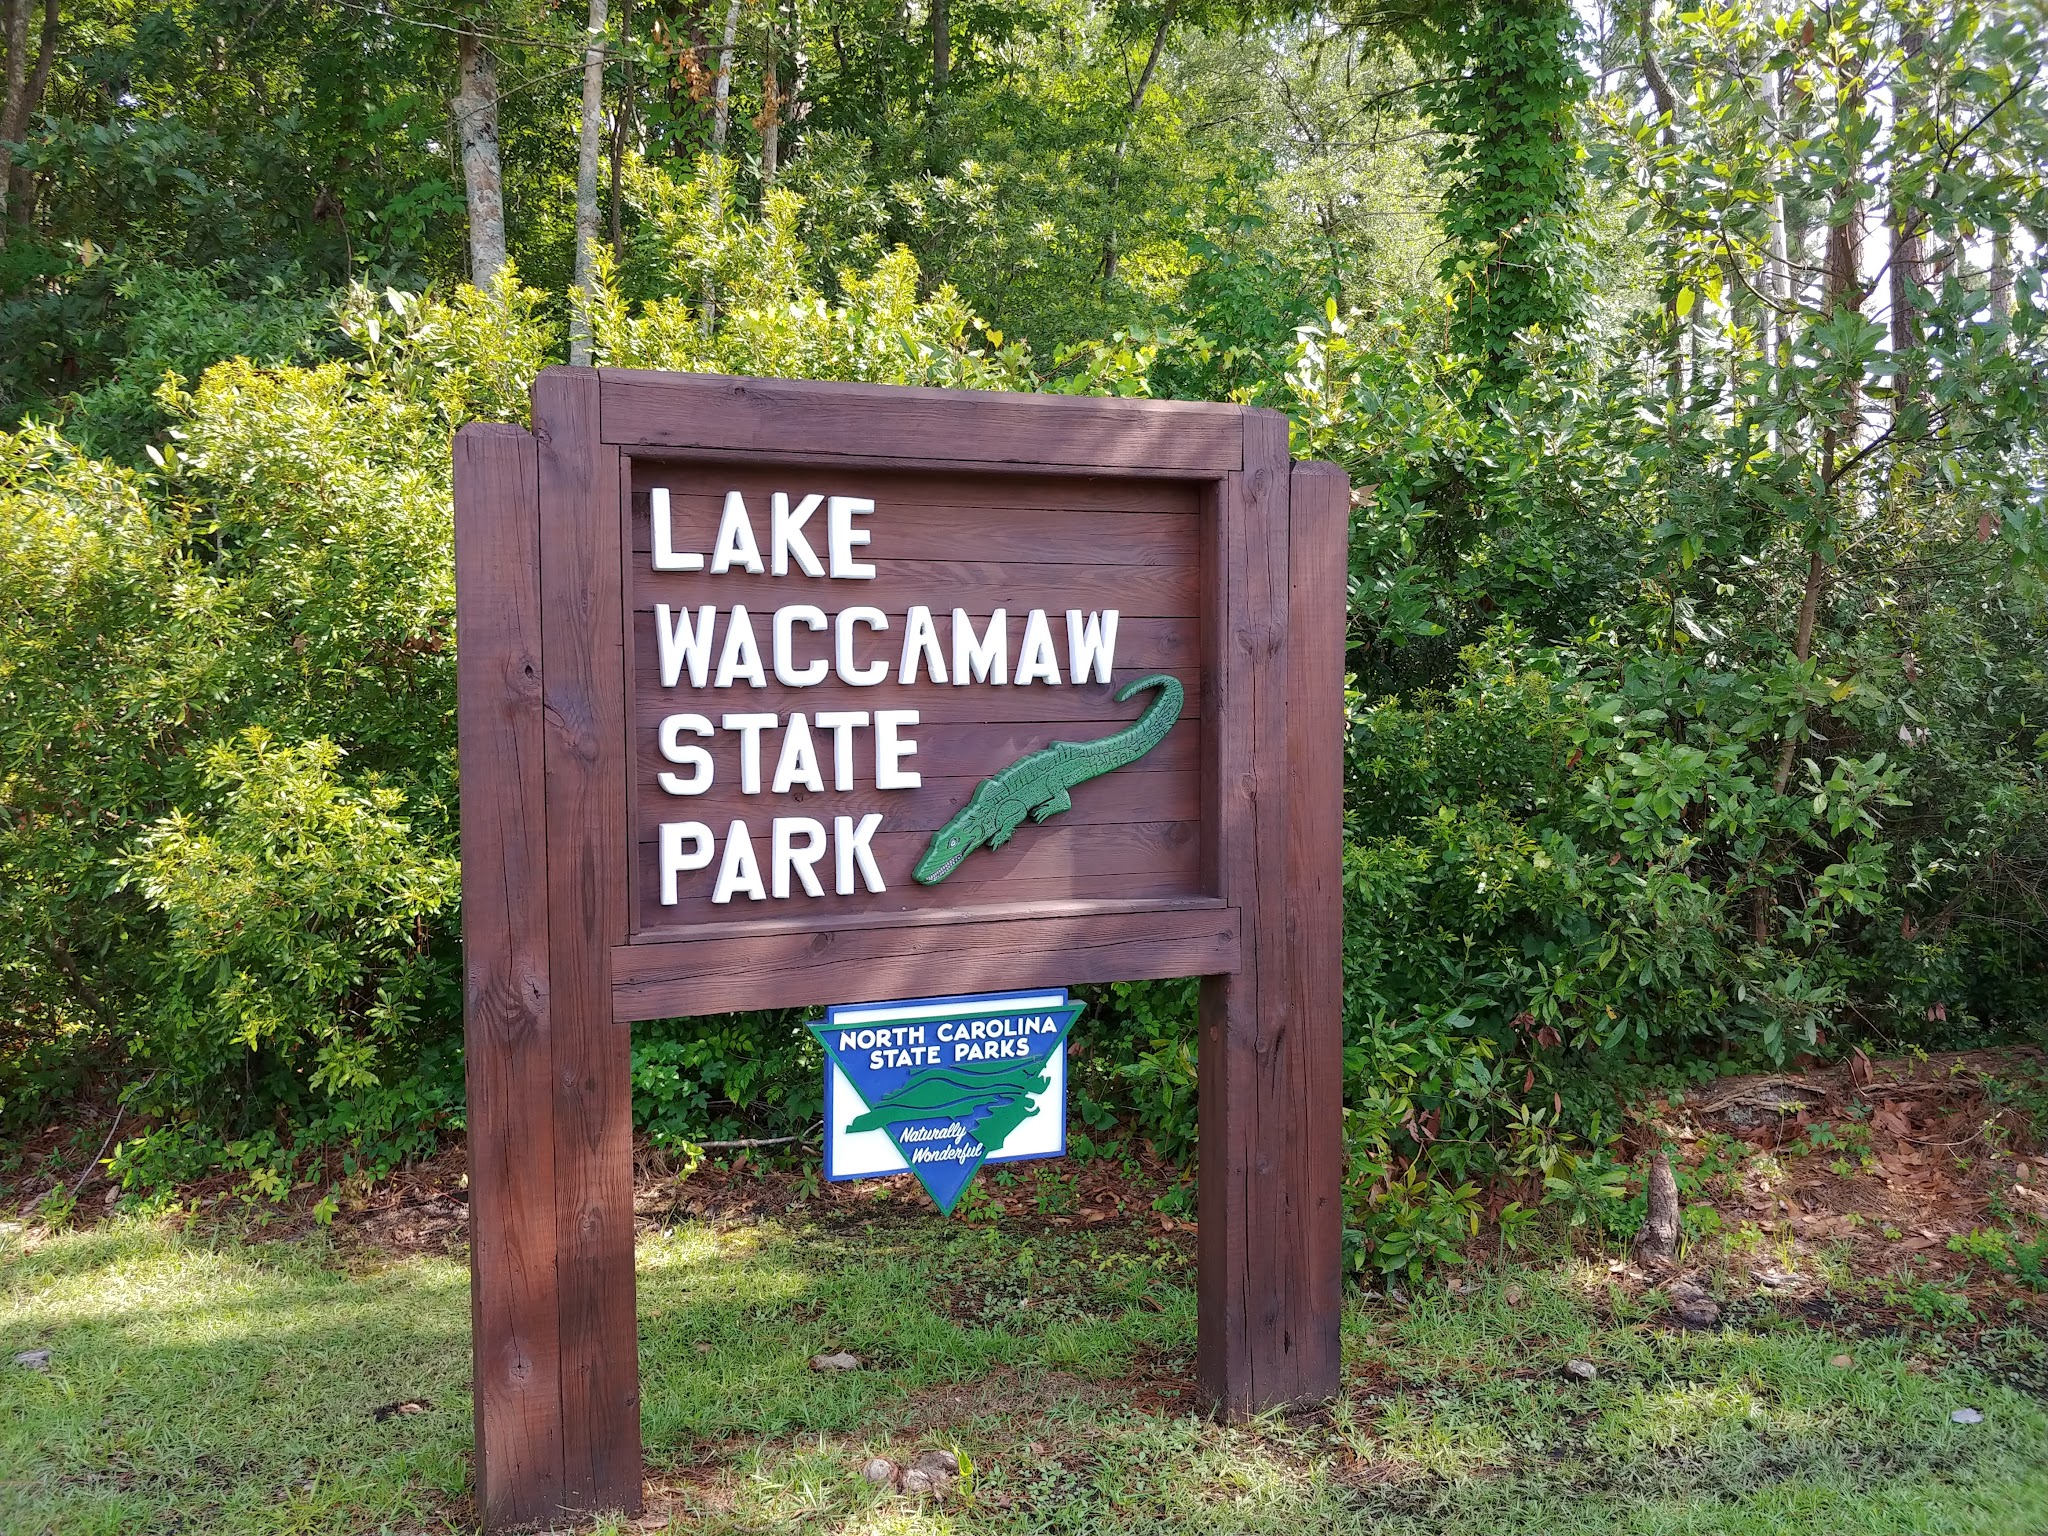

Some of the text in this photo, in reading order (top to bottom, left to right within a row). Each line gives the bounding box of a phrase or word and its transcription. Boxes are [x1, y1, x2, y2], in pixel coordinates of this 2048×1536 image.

[650, 487, 876, 579] LAKE
[654, 603, 1119, 688] WACCAMAW
[656, 709, 921, 795] STATE
[658, 813, 886, 905] PARK
[839, 1016, 1058, 1052] NORTH CAROLINA
[870, 1038, 1030, 1070] STATE PARKS
[900, 1122, 967, 1144] Naturally
[912, 1142, 983, 1165] Wonderful
